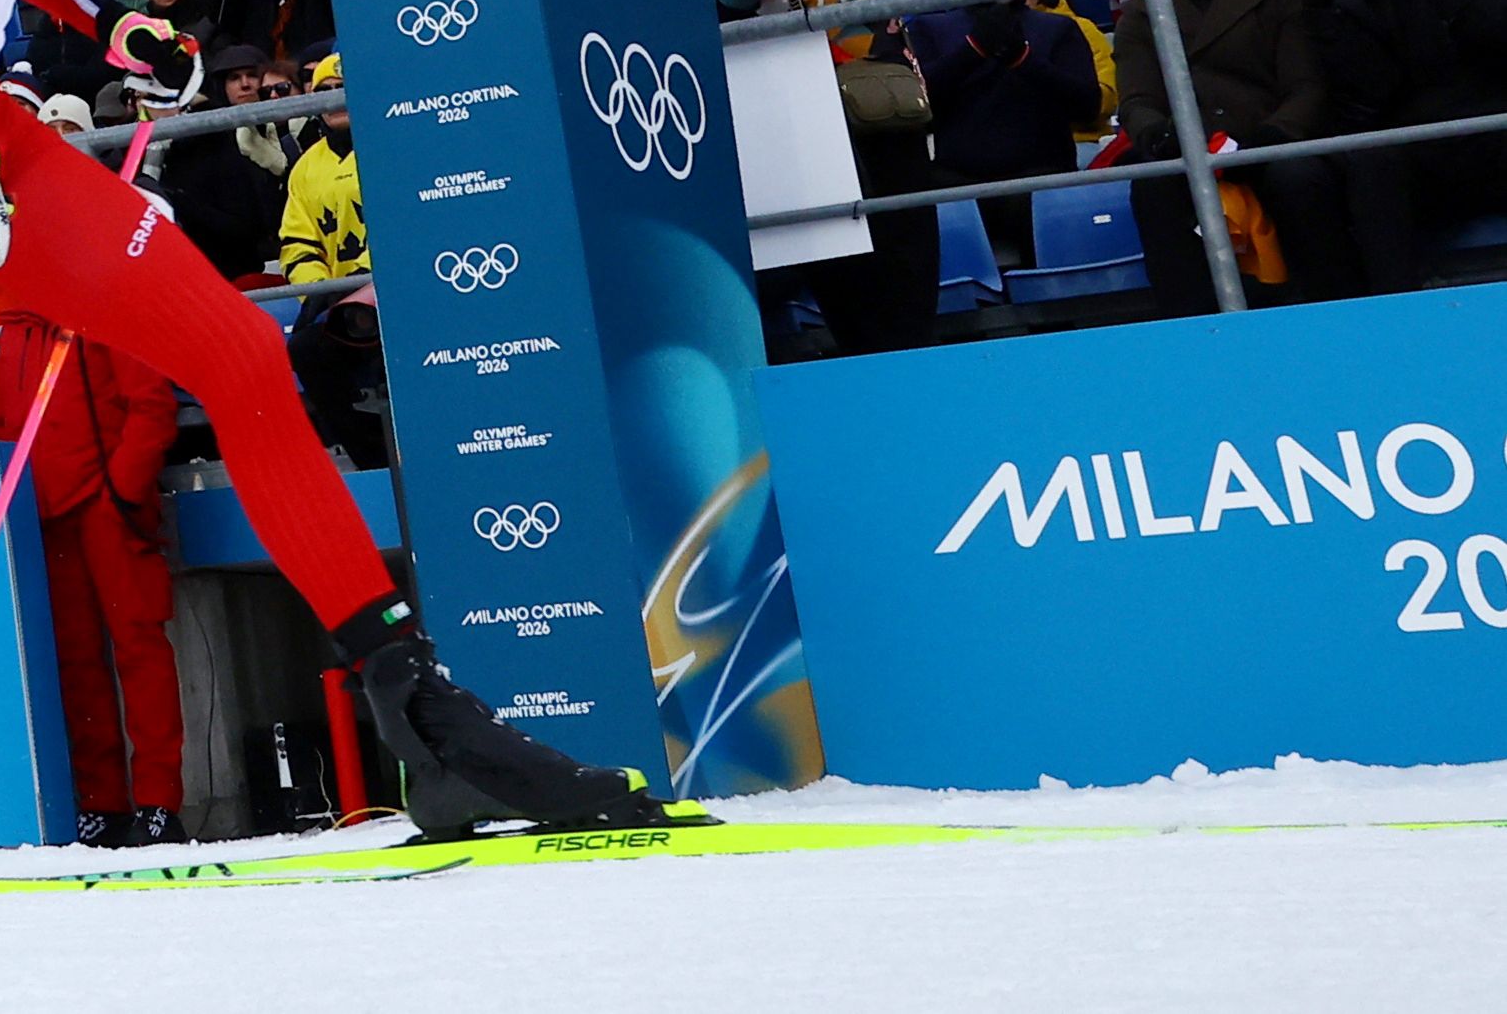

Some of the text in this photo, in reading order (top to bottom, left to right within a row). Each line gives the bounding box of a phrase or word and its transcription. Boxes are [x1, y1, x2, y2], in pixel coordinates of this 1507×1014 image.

[386, 84, 520, 120] MILANO CORTINA
[437, 104, 470, 124] 2026
[434, 170, 489, 188] OLYMPIC
[418, 182, 465, 202] WINTER
[423, 336, 561, 369] MILANO CORTINA
[473, 355, 510, 375] 2026
[473, 425, 528, 442] OLYMPIC
[456, 438, 503, 455] WINTER
[934, 423, 1481, 556] MILANO
[461, 601, 605, 628] MILANO CORTINA
[513, 617, 551, 637] 2026
[513, 691, 569, 705] OLYMPIC
[496, 703, 542, 719] WINTER
[534, 831, 671, 854] FISCHER
